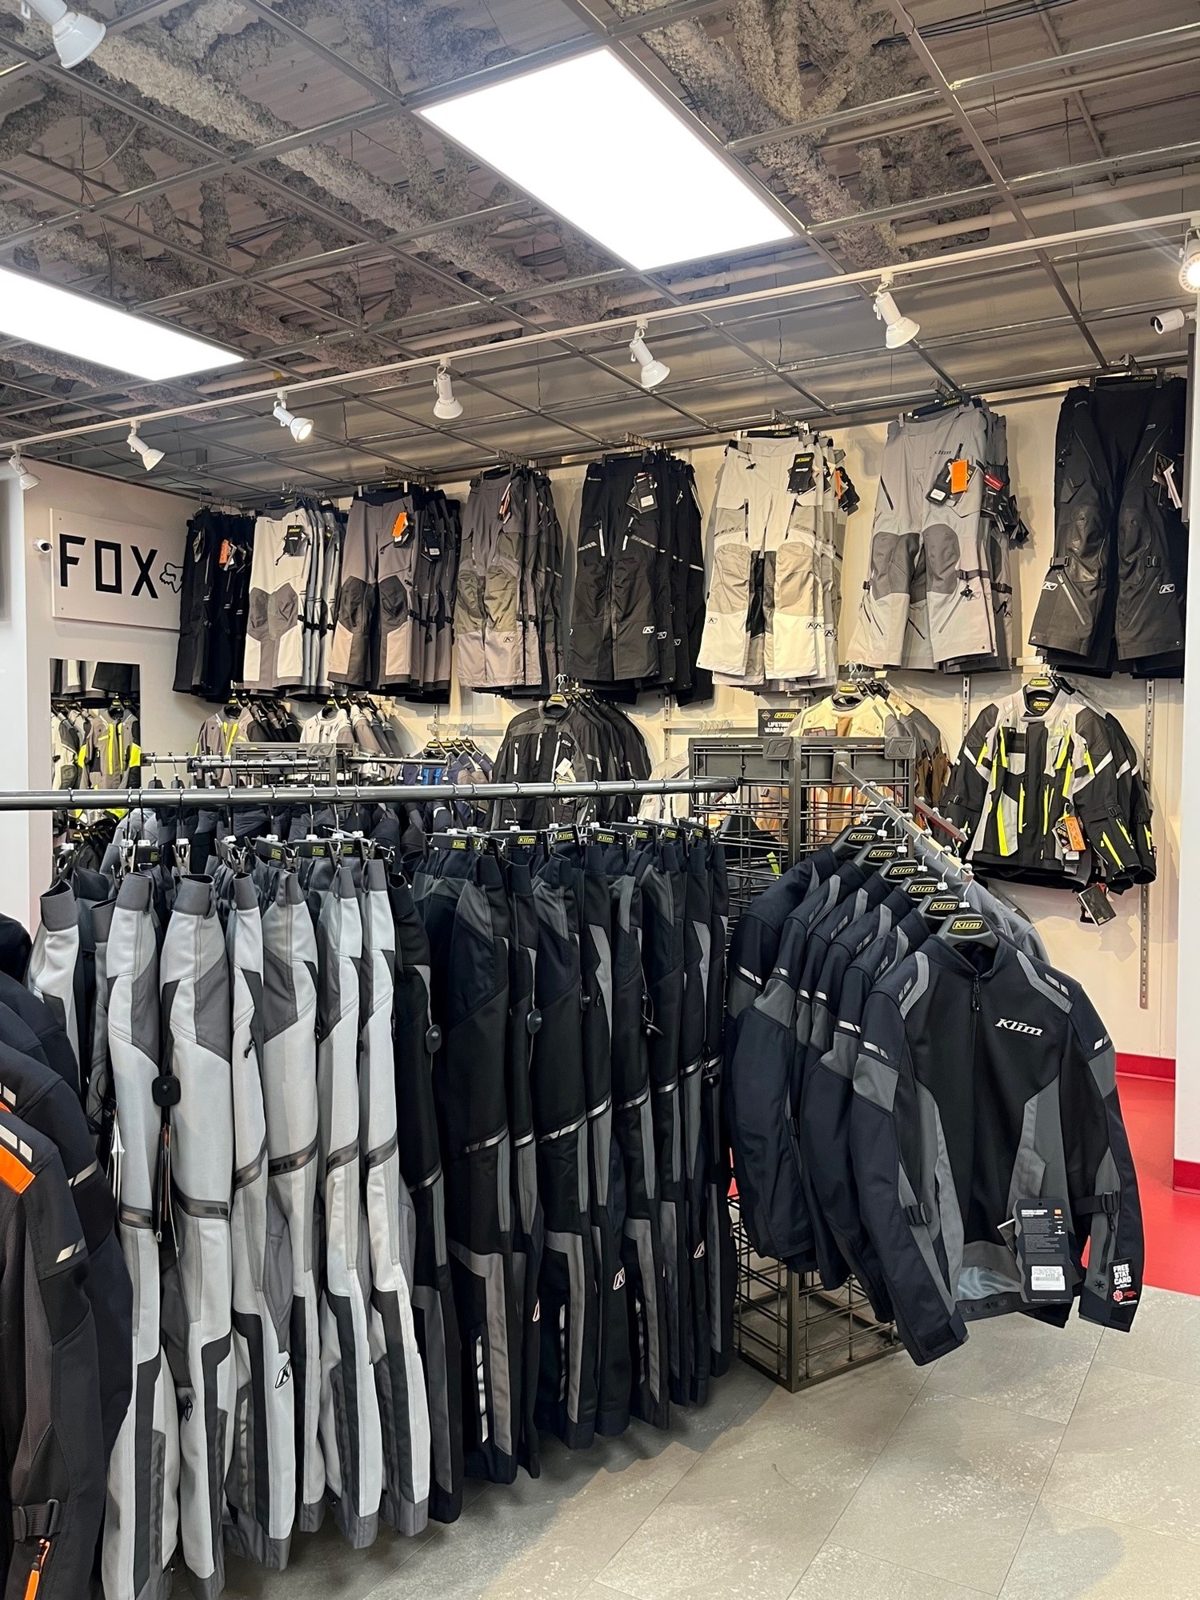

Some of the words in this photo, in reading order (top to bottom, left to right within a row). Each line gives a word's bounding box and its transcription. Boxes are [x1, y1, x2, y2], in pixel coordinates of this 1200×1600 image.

[59, 533, 159, 599] FOX
[848, 832, 876, 841] Klim
[869, 849, 896, 858] Klim
[890, 865, 916, 875] Klim
[908, 884, 936, 893] Klim
[930, 901, 958, 911] Klim
[953, 920, 983, 930] Klim
[995, 1018, 1043, 1037] Klim
[1113, 1263, 1129, 1273] FREE
[1114, 1270, 1129, 1279] STAT
[1114, 1275, 1132, 1286] CARD
